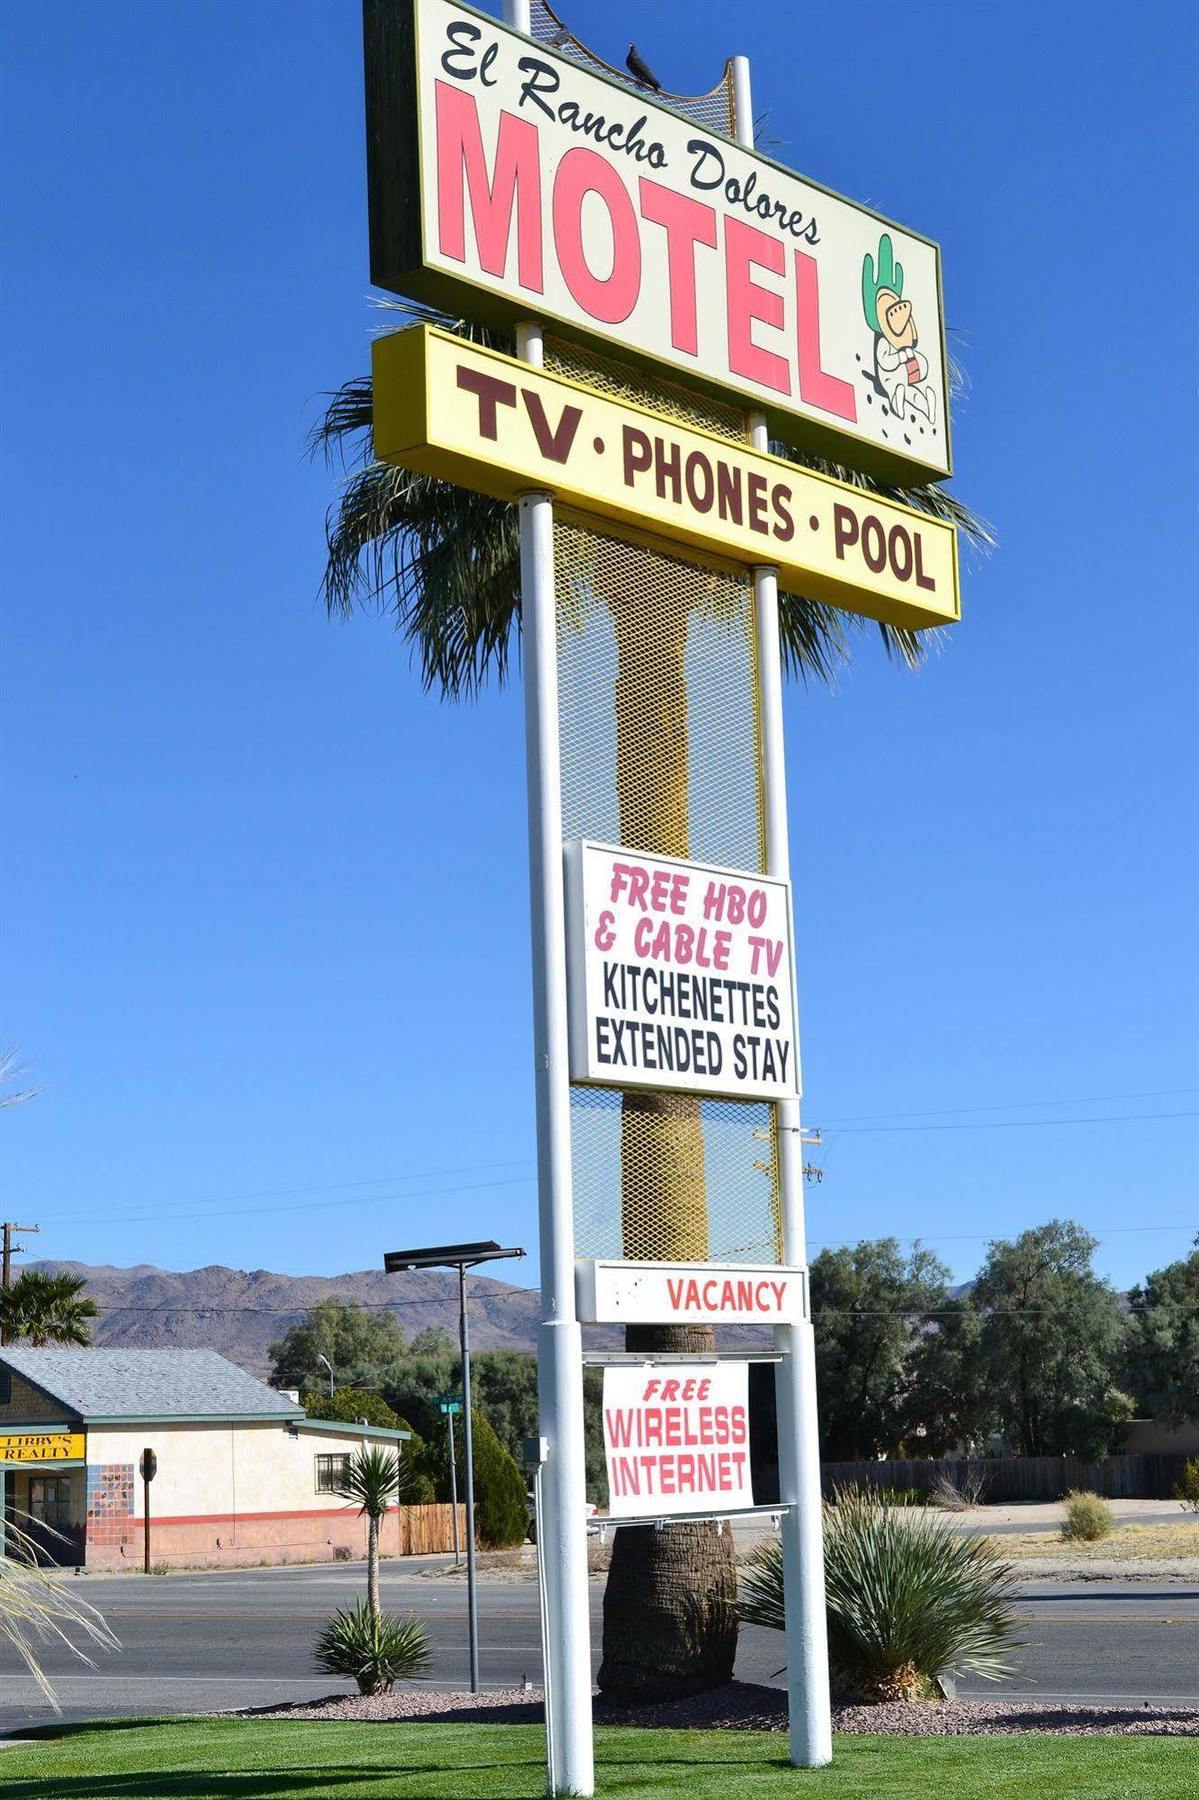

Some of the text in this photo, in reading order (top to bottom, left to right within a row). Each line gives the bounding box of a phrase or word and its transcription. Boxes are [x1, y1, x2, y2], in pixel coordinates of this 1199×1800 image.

[441, 21, 820, 245] El Rancho Dolores
[434, 78, 857, 423] MOTEL
[456, 364, 936, 592] TV PHONES POOL
[610, 862, 768, 928] FREE HBO
[594, 910, 784, 978] & CABLE TV
[603, 961, 780, 1030] KITCHENETTES
[596, 1016, 789, 1083] EXTENDED STAY
[666, 1278, 787, 1312] VACANCY
[642, 1379, 712, 1402] FREE
[5, 1447, 72, 1459] REALTY
[605, 1405, 746, 1448] WIRELESS
[611, 1452, 746, 1496] INTERNET
